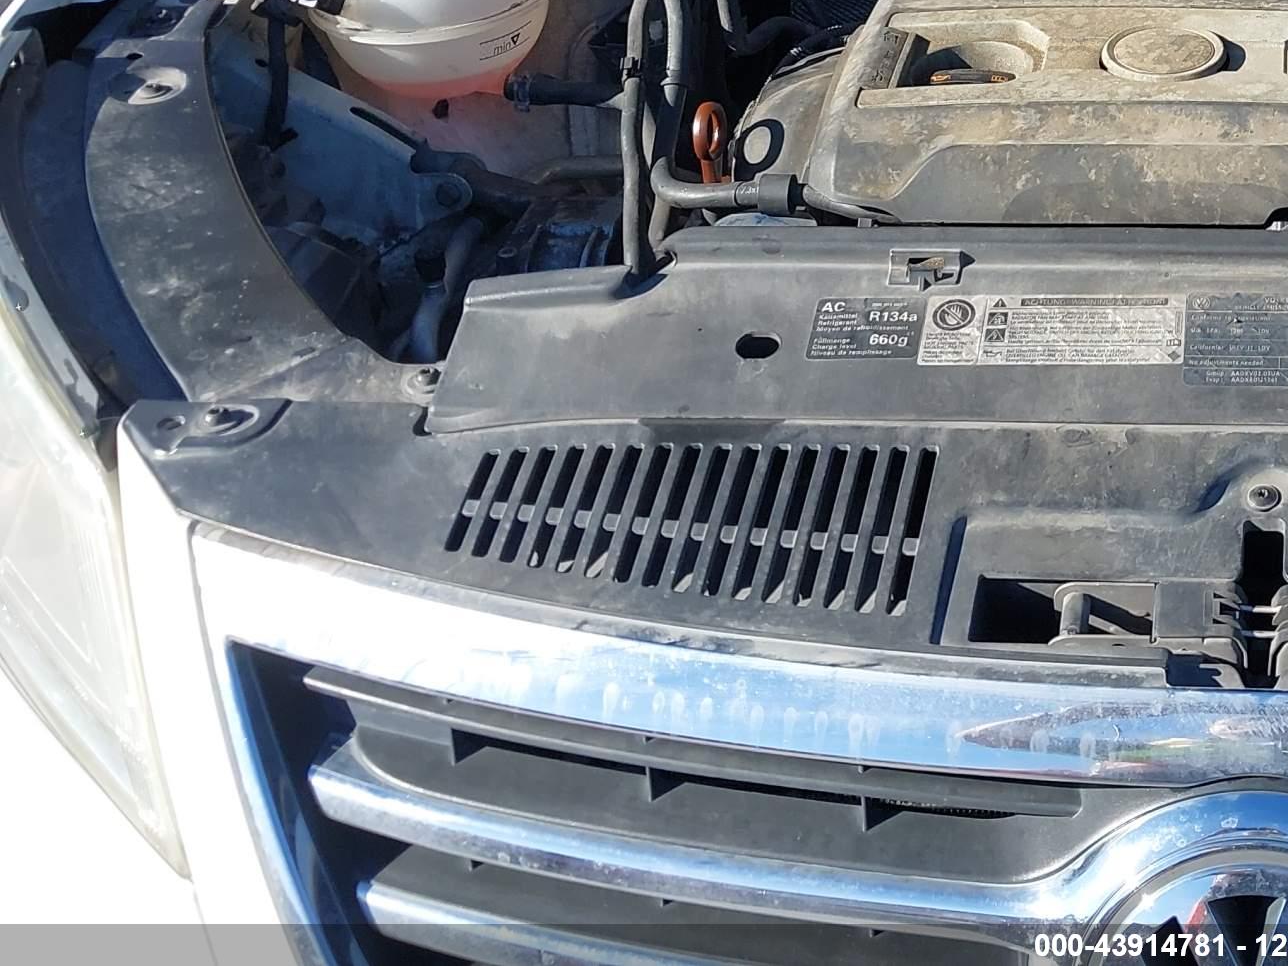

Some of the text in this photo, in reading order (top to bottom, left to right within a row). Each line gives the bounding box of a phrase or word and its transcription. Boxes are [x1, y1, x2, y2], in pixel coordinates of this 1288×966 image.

[493, 42, 511, 56] min
[821, 301, 846, 313] AC
[869, 311, 918, 322] R134a
[869, 333, 908, 347] 660g
